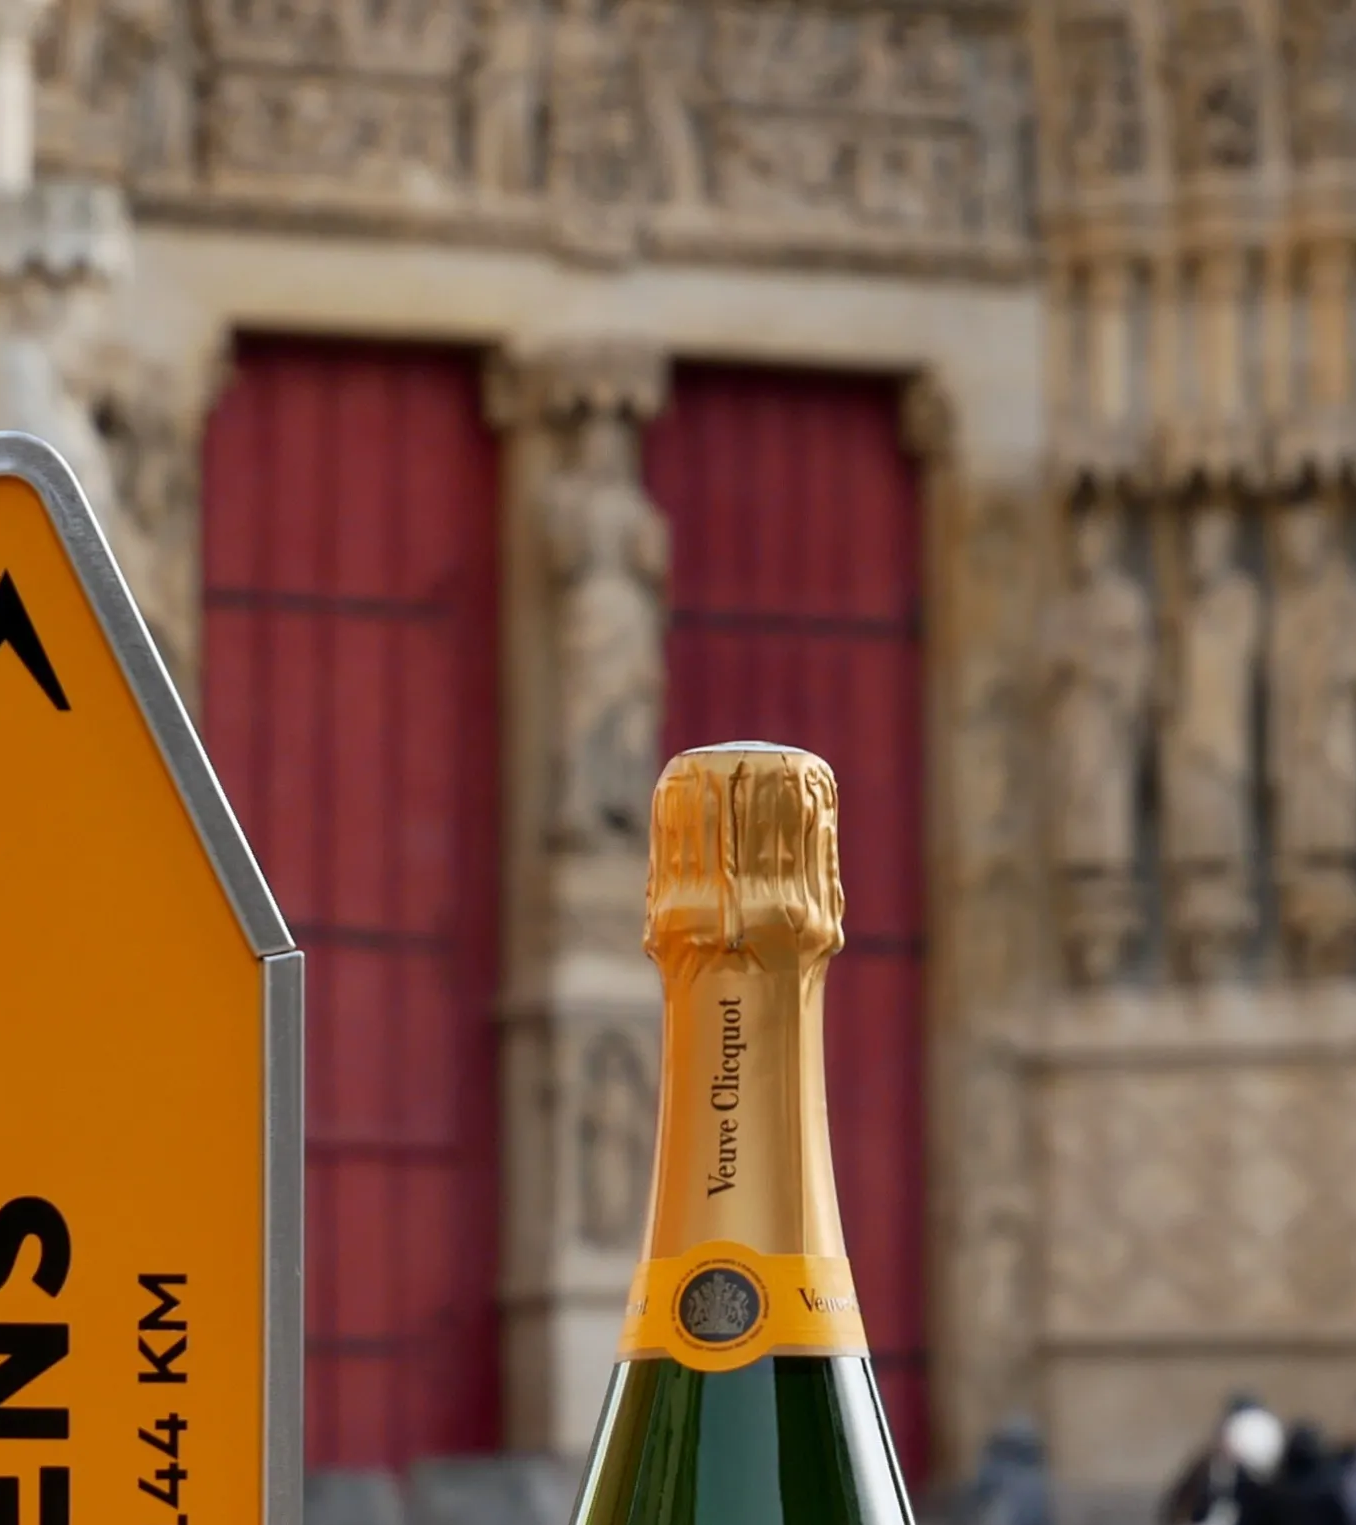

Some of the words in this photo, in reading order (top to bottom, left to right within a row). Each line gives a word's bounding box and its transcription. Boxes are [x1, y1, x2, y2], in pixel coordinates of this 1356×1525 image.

[710, 996, 749, 1111] Clicquot
[706, 1118, 738, 1199] Veuve
[137, 1273, 188, 1384] KM
